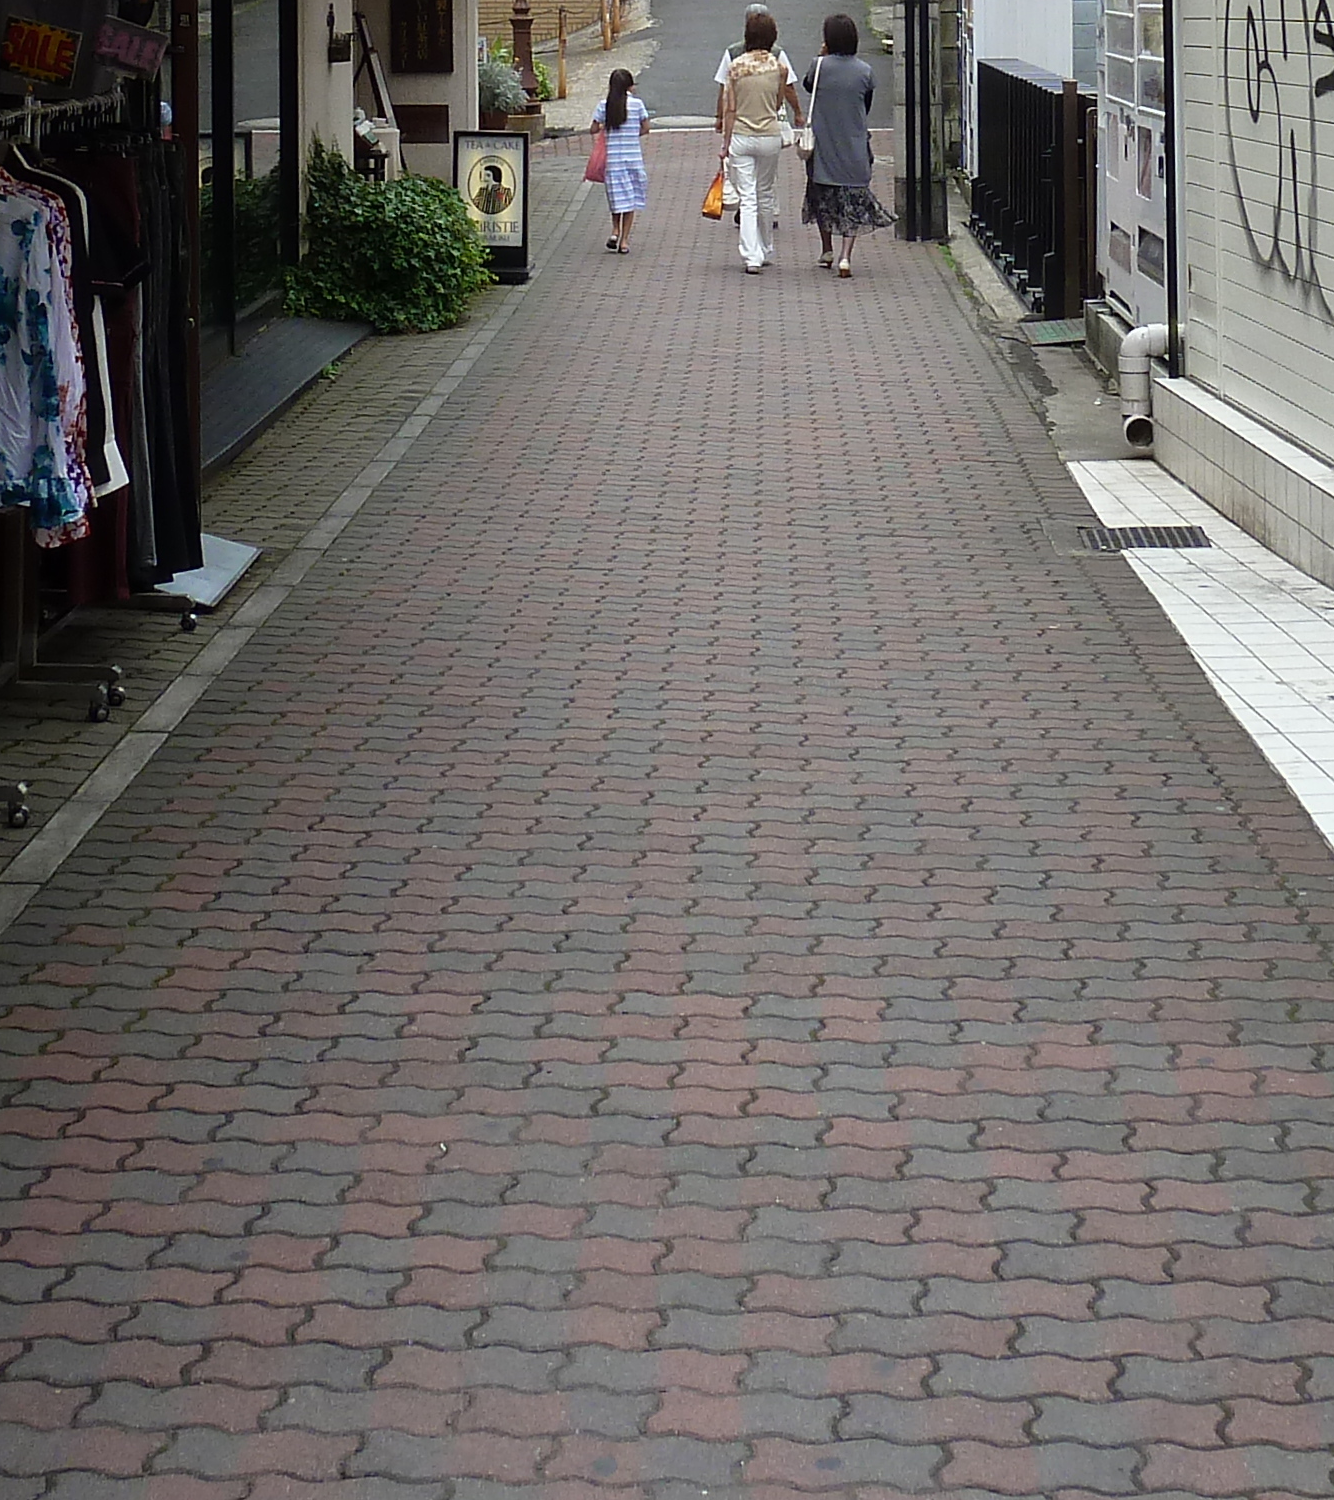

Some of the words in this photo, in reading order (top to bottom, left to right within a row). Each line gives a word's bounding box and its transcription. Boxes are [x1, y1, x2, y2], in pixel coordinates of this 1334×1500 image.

[2, 24, 77, 78] SALE
[465, 140, 483, 150] TEA
[493, 140, 521, 150] CAKE
